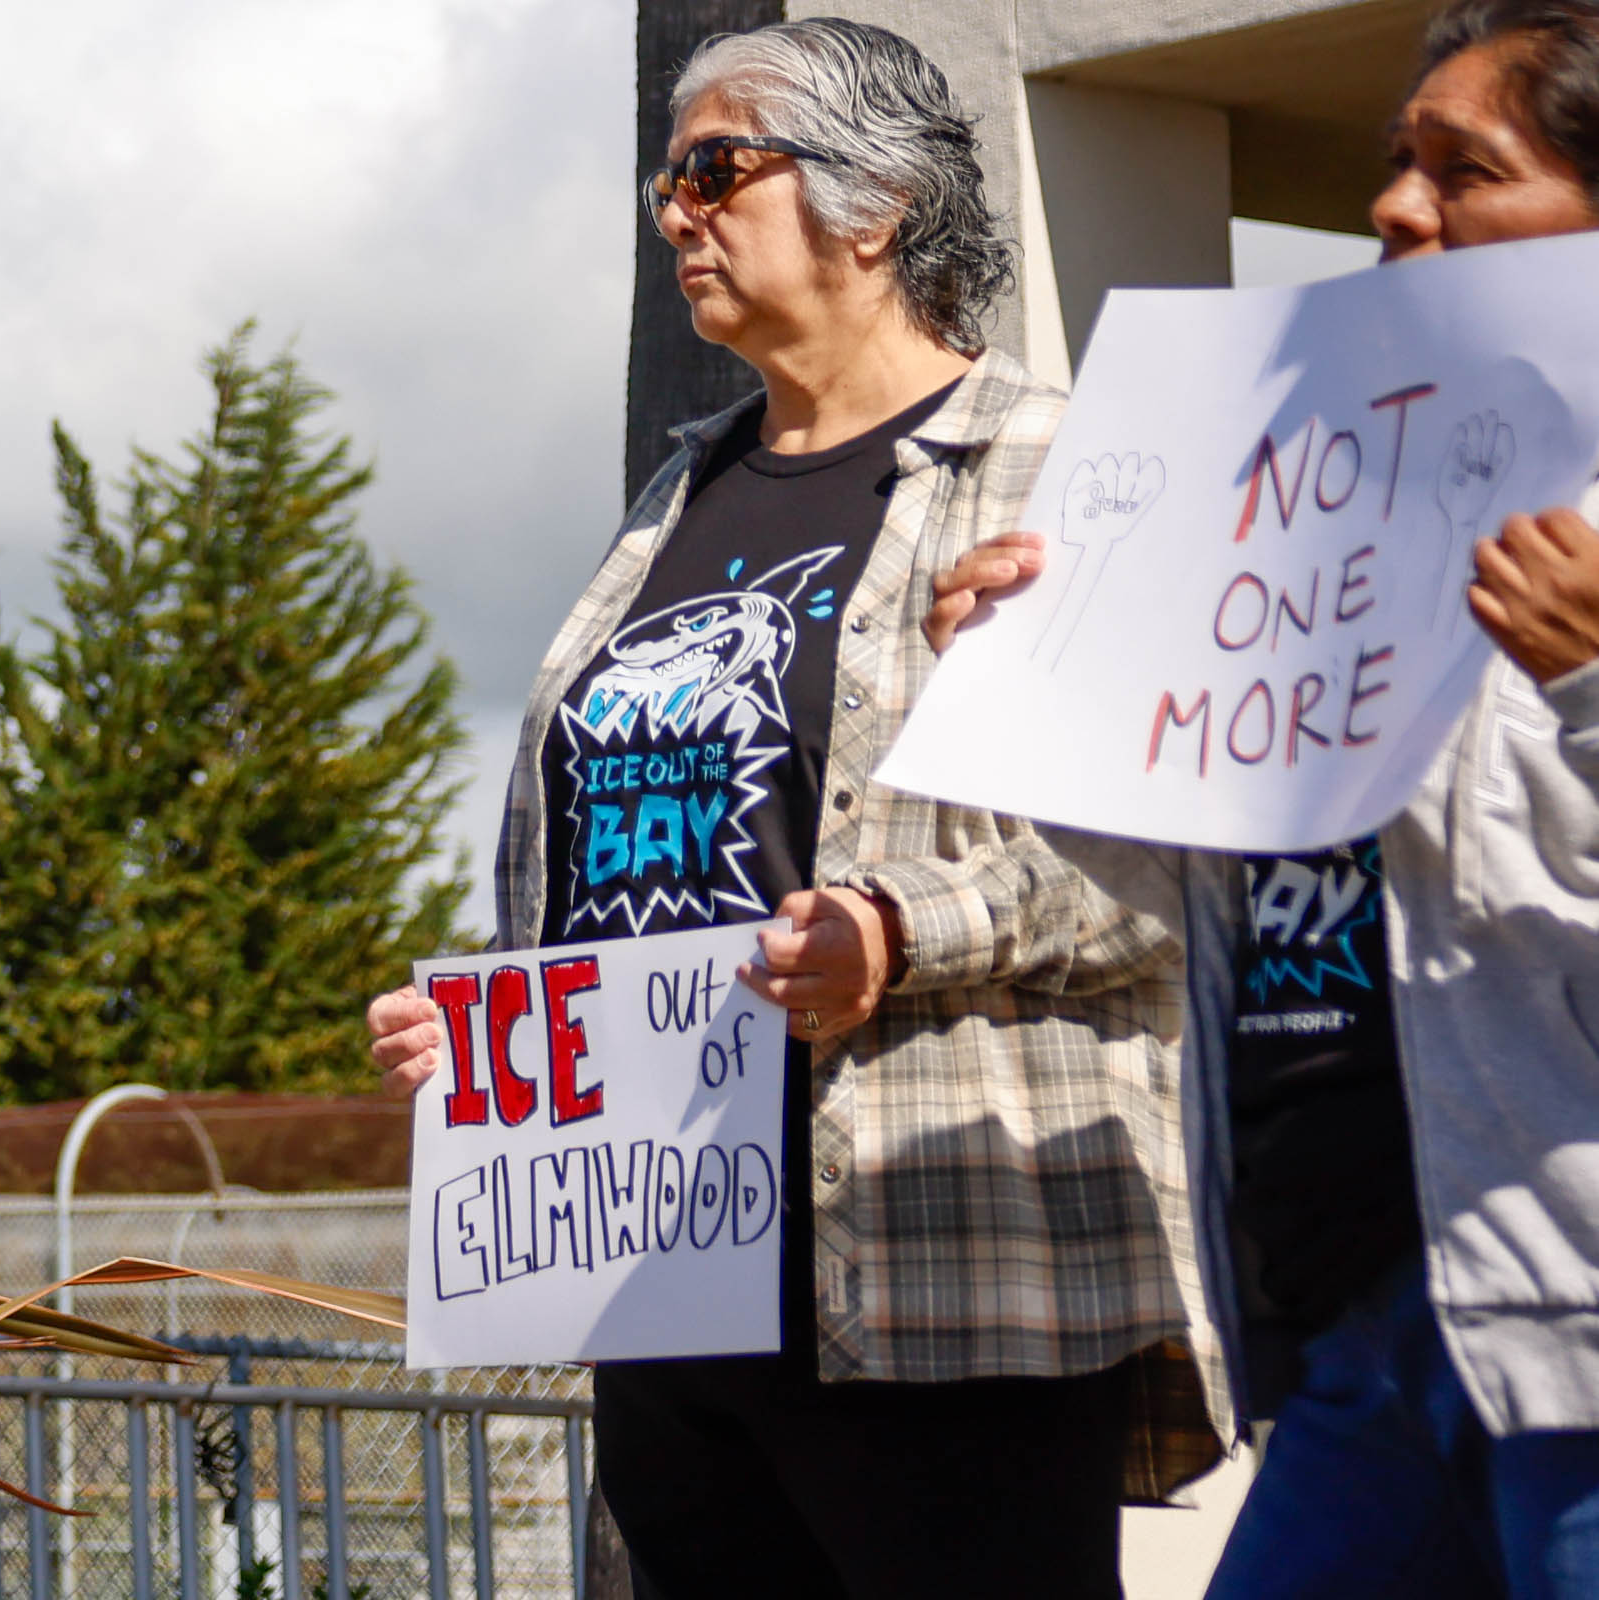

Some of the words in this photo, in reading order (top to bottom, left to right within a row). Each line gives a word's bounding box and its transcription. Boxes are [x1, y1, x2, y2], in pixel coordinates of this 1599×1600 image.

[1234, 382, 1438, 543] NOT
[1213, 544, 1375, 652] ONE
[1145, 644, 1396, 778] MORE
[587, 755, 643, 794] ICE
[646, 747, 699, 787] OUT
[705, 743, 725, 761] OF
[702, 763, 728, 782] THE
[587, 788, 729, 886] BAY
[1243, 857, 1368, 947] AY
[427, 954, 604, 1129] ICE
[434, 1138, 777, 1301] ELMWOOD
